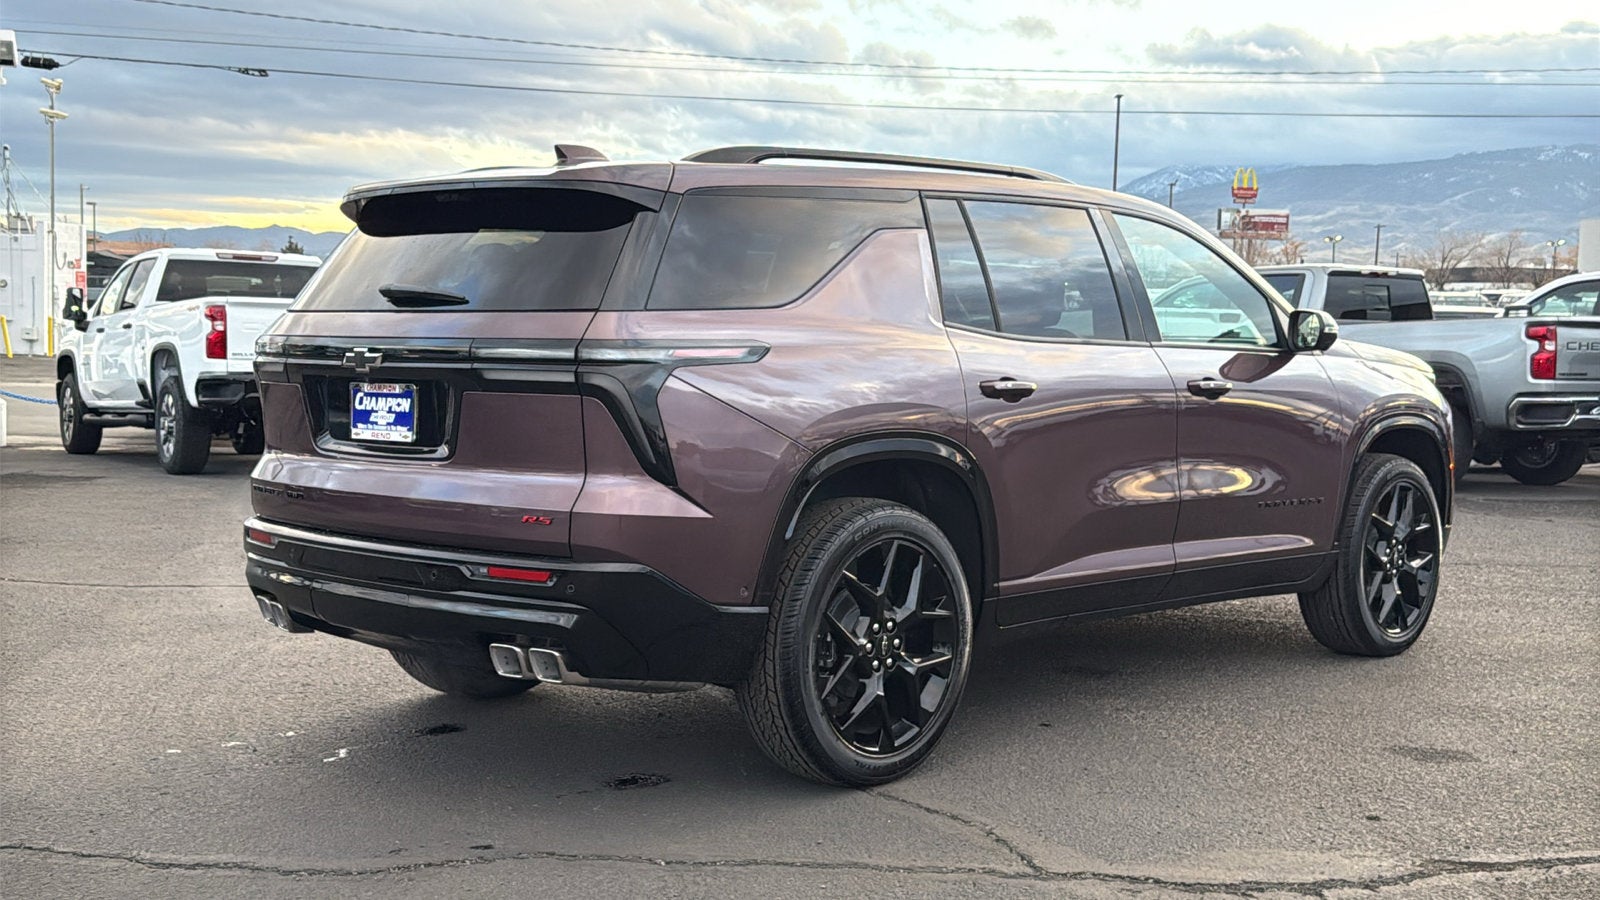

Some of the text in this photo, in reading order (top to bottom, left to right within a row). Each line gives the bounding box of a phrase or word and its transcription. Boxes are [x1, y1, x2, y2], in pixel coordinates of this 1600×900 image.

[366, 384, 398, 392] CHAMPION
[354, 392, 411, 413] CHAMPION
[370, 432, 392, 440] RENO
[521, 515, 553, 525] RS
